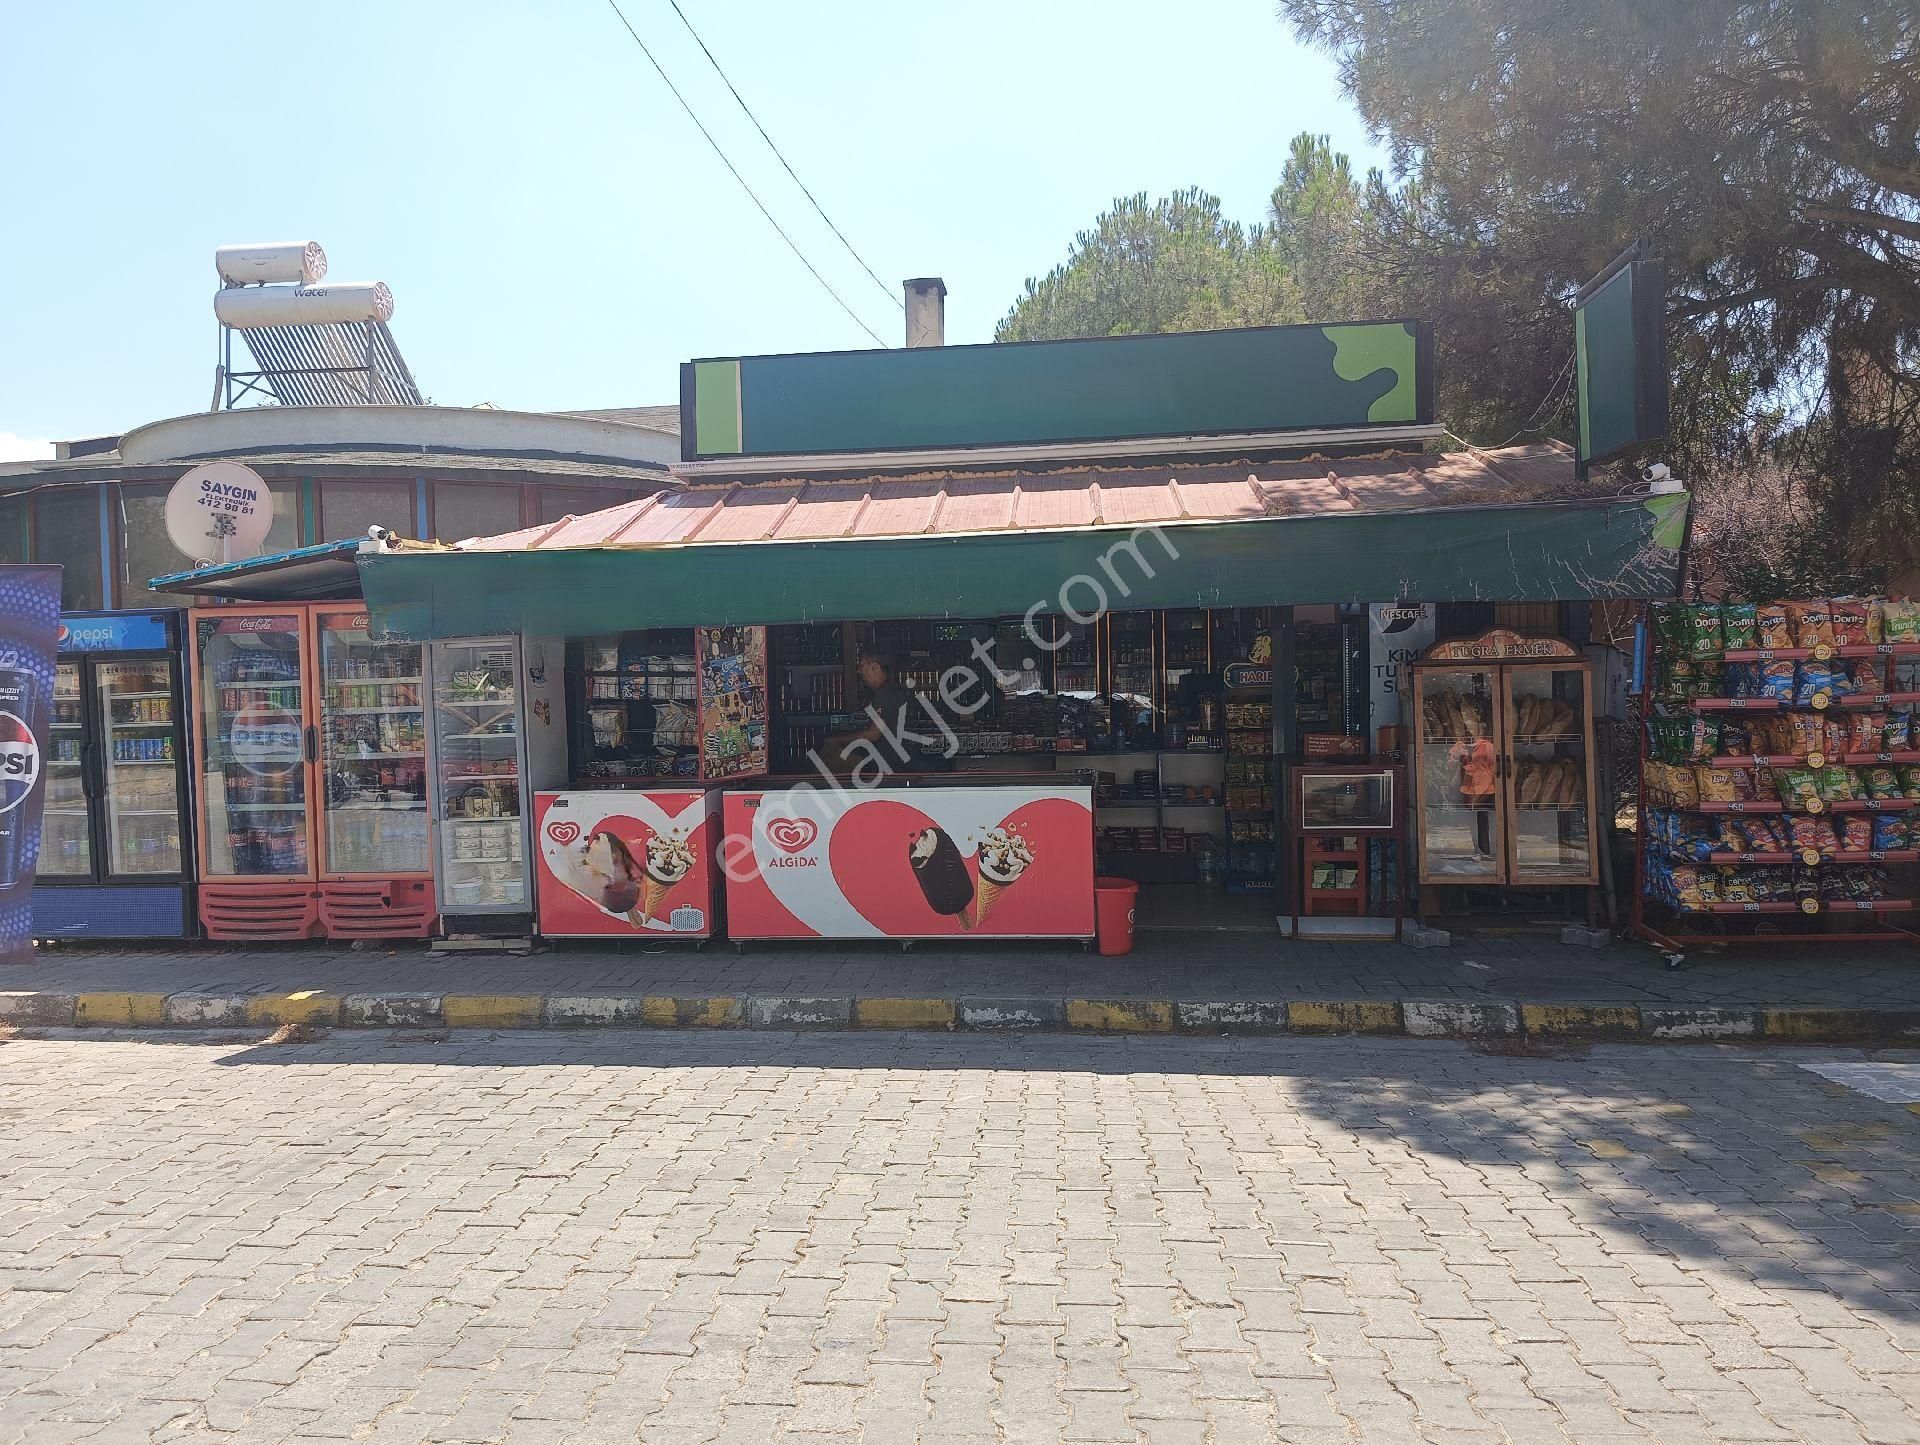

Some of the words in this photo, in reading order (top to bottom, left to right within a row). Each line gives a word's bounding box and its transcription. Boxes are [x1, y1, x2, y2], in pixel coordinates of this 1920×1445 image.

[200, 479, 257, 502] SAYGIN
[197, 498, 221, 509] 412
[224, 503, 239, 512] 98
[241, 506, 254, 515] 81
[73, 627, 113, 642] pepsi
[1452, 644, 1499, 658] TUĞRA
[1505, 643, 1553, 656] EKMEK
